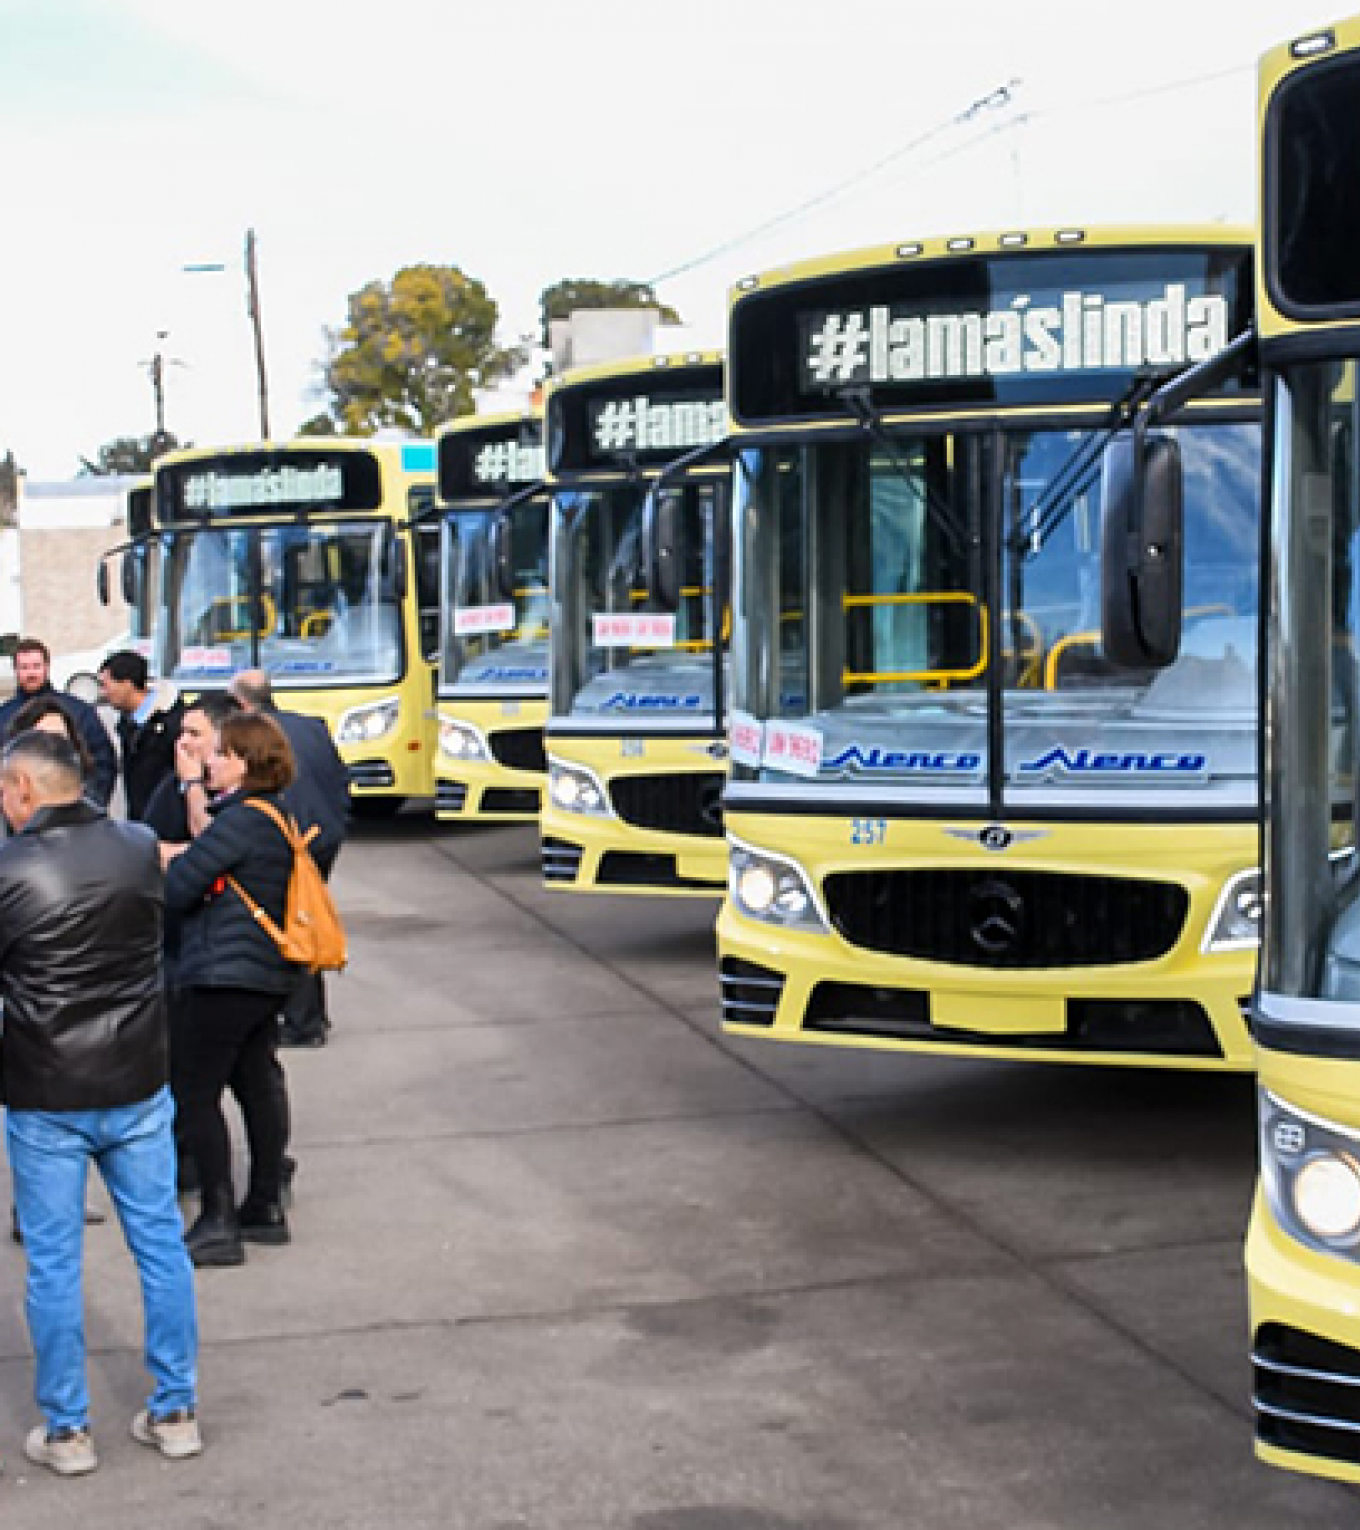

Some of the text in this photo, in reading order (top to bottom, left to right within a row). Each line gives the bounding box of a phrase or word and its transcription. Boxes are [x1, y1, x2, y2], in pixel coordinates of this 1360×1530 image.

[808, 284, 1229, 382] #lamáslinda
[820, 746, 981, 768] Alenco
[1019, 748, 1206, 771] Alenco
